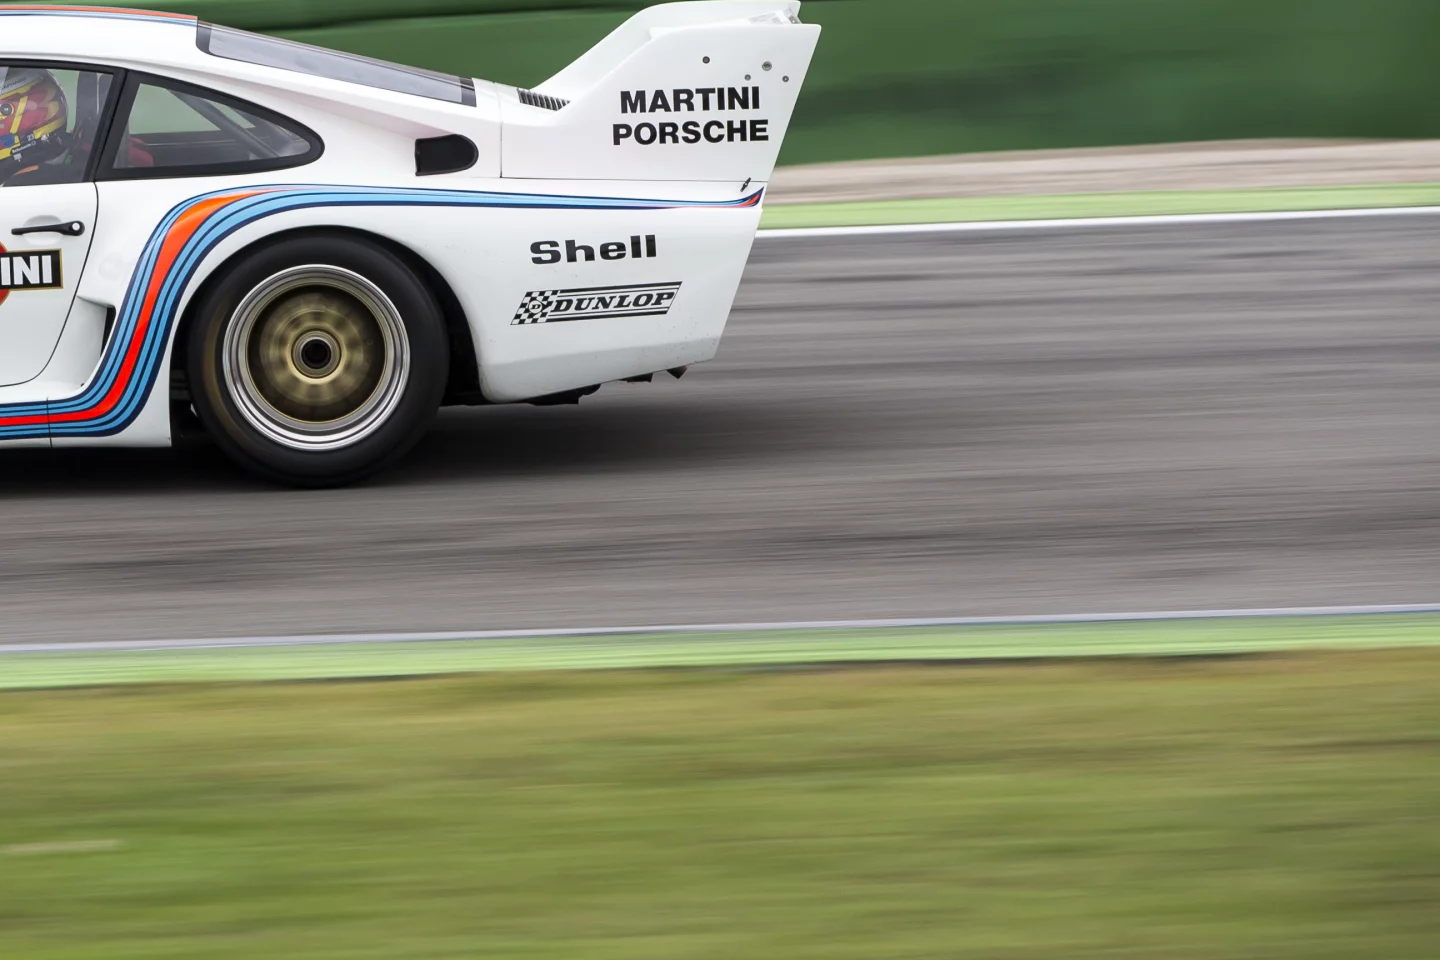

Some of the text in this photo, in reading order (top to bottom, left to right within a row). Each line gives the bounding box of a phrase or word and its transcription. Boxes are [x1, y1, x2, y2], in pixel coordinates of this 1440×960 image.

[620, 85, 760, 114] MARTINI
[612, 118, 769, 146] PORSCHE
[529, 234, 657, 265] Shell
[550, 291, 675, 313] DUNLOP
